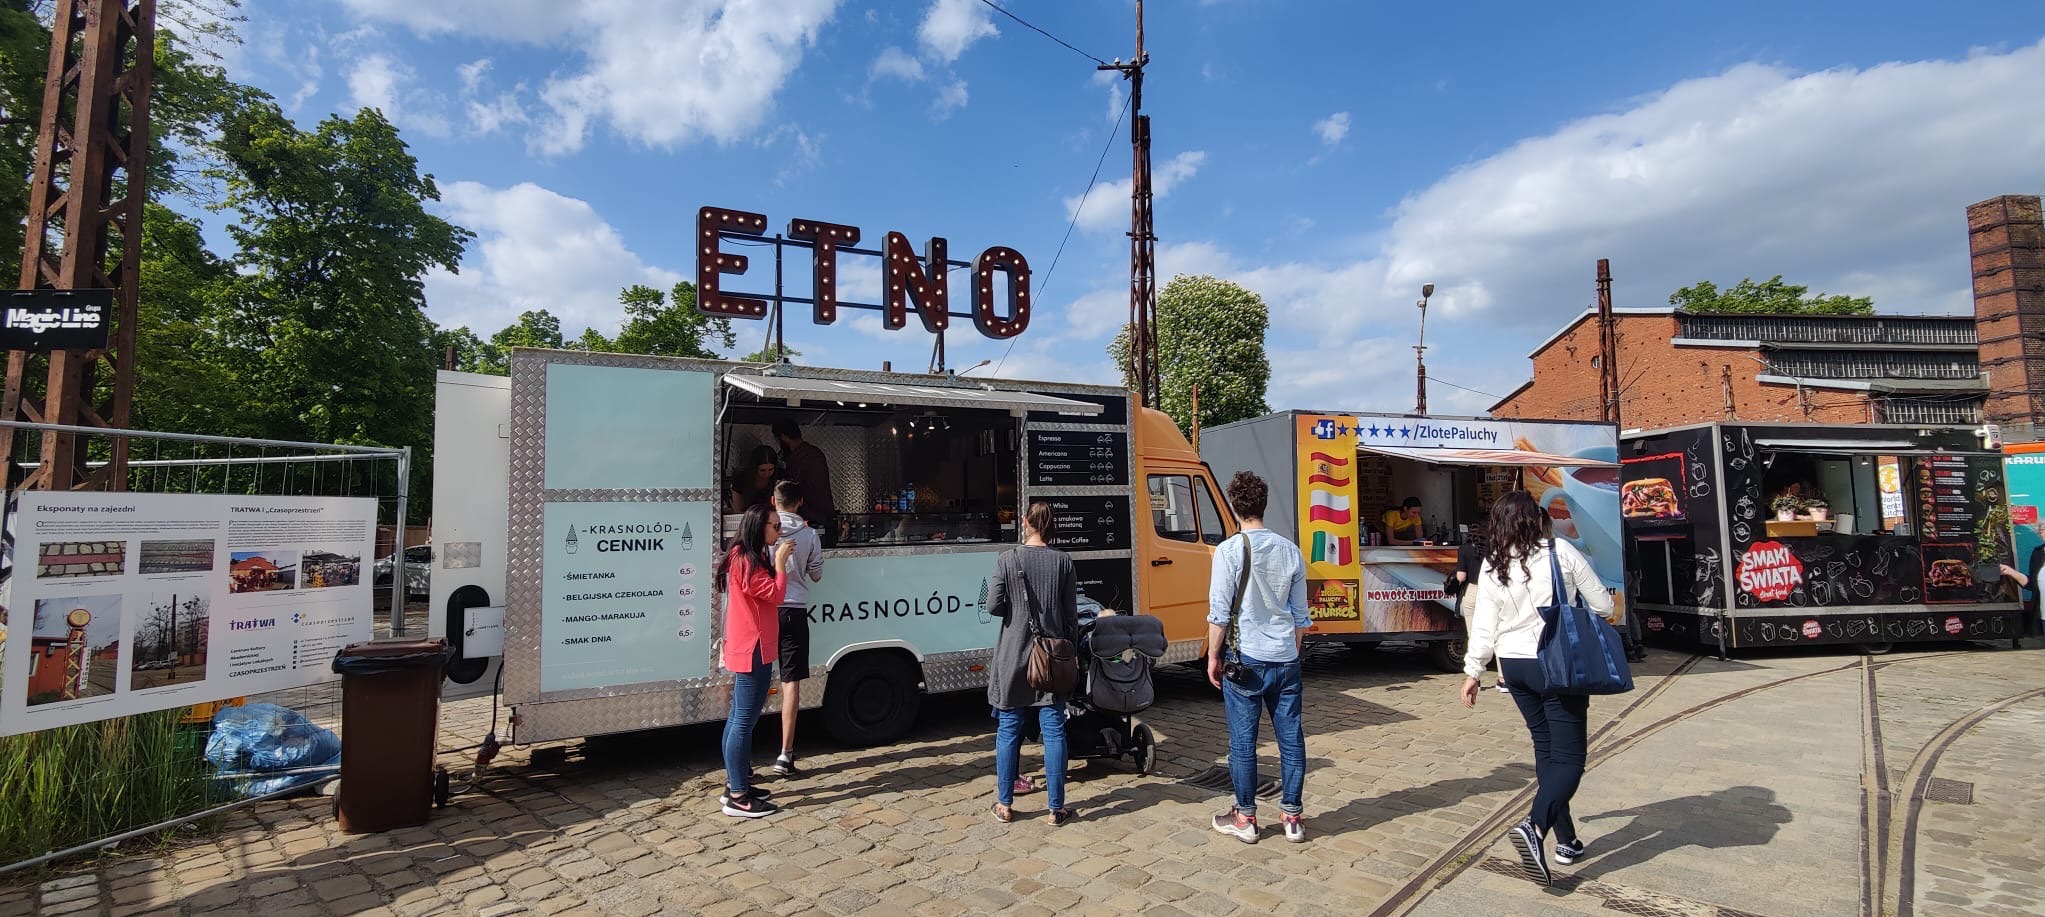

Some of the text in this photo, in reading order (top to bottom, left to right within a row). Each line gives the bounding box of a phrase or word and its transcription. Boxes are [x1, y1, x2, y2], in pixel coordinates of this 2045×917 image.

[696, 206, 1031, 339] ETNO
[1038, 434, 1062, 444] Espresso
[1039, 462, 1071, 471] Cappuccino
[37, 505, 86, 514] Eksponaty
[100, 505, 136, 514] zajezdni
[596, 538, 664, 552] CENNIK
[1071, 536, 1089, 544] Coffee
[1742, 547, 1790, 571] SMAKI
[566, 571, 616, 581] ŚMIETANKA
[566, 591, 613, 601] BELGIJSKA
[614, 588, 664, 599] CZEKOLADA
[1367, 588, 1407, 600] NOWOŚĆ
[1407, 590, 1415, 600] Z
[565, 611, 646, 623] MANGO-MARAKUJA
[1309, 606, 1358, 619] CHURROS
[229, 618, 276, 631] TRATWA
[564, 637, 589, 645] SMAK
[591, 634, 612, 643] DNIA
[229, 664, 286, 678] CZASOPRZESTRZEŃ
